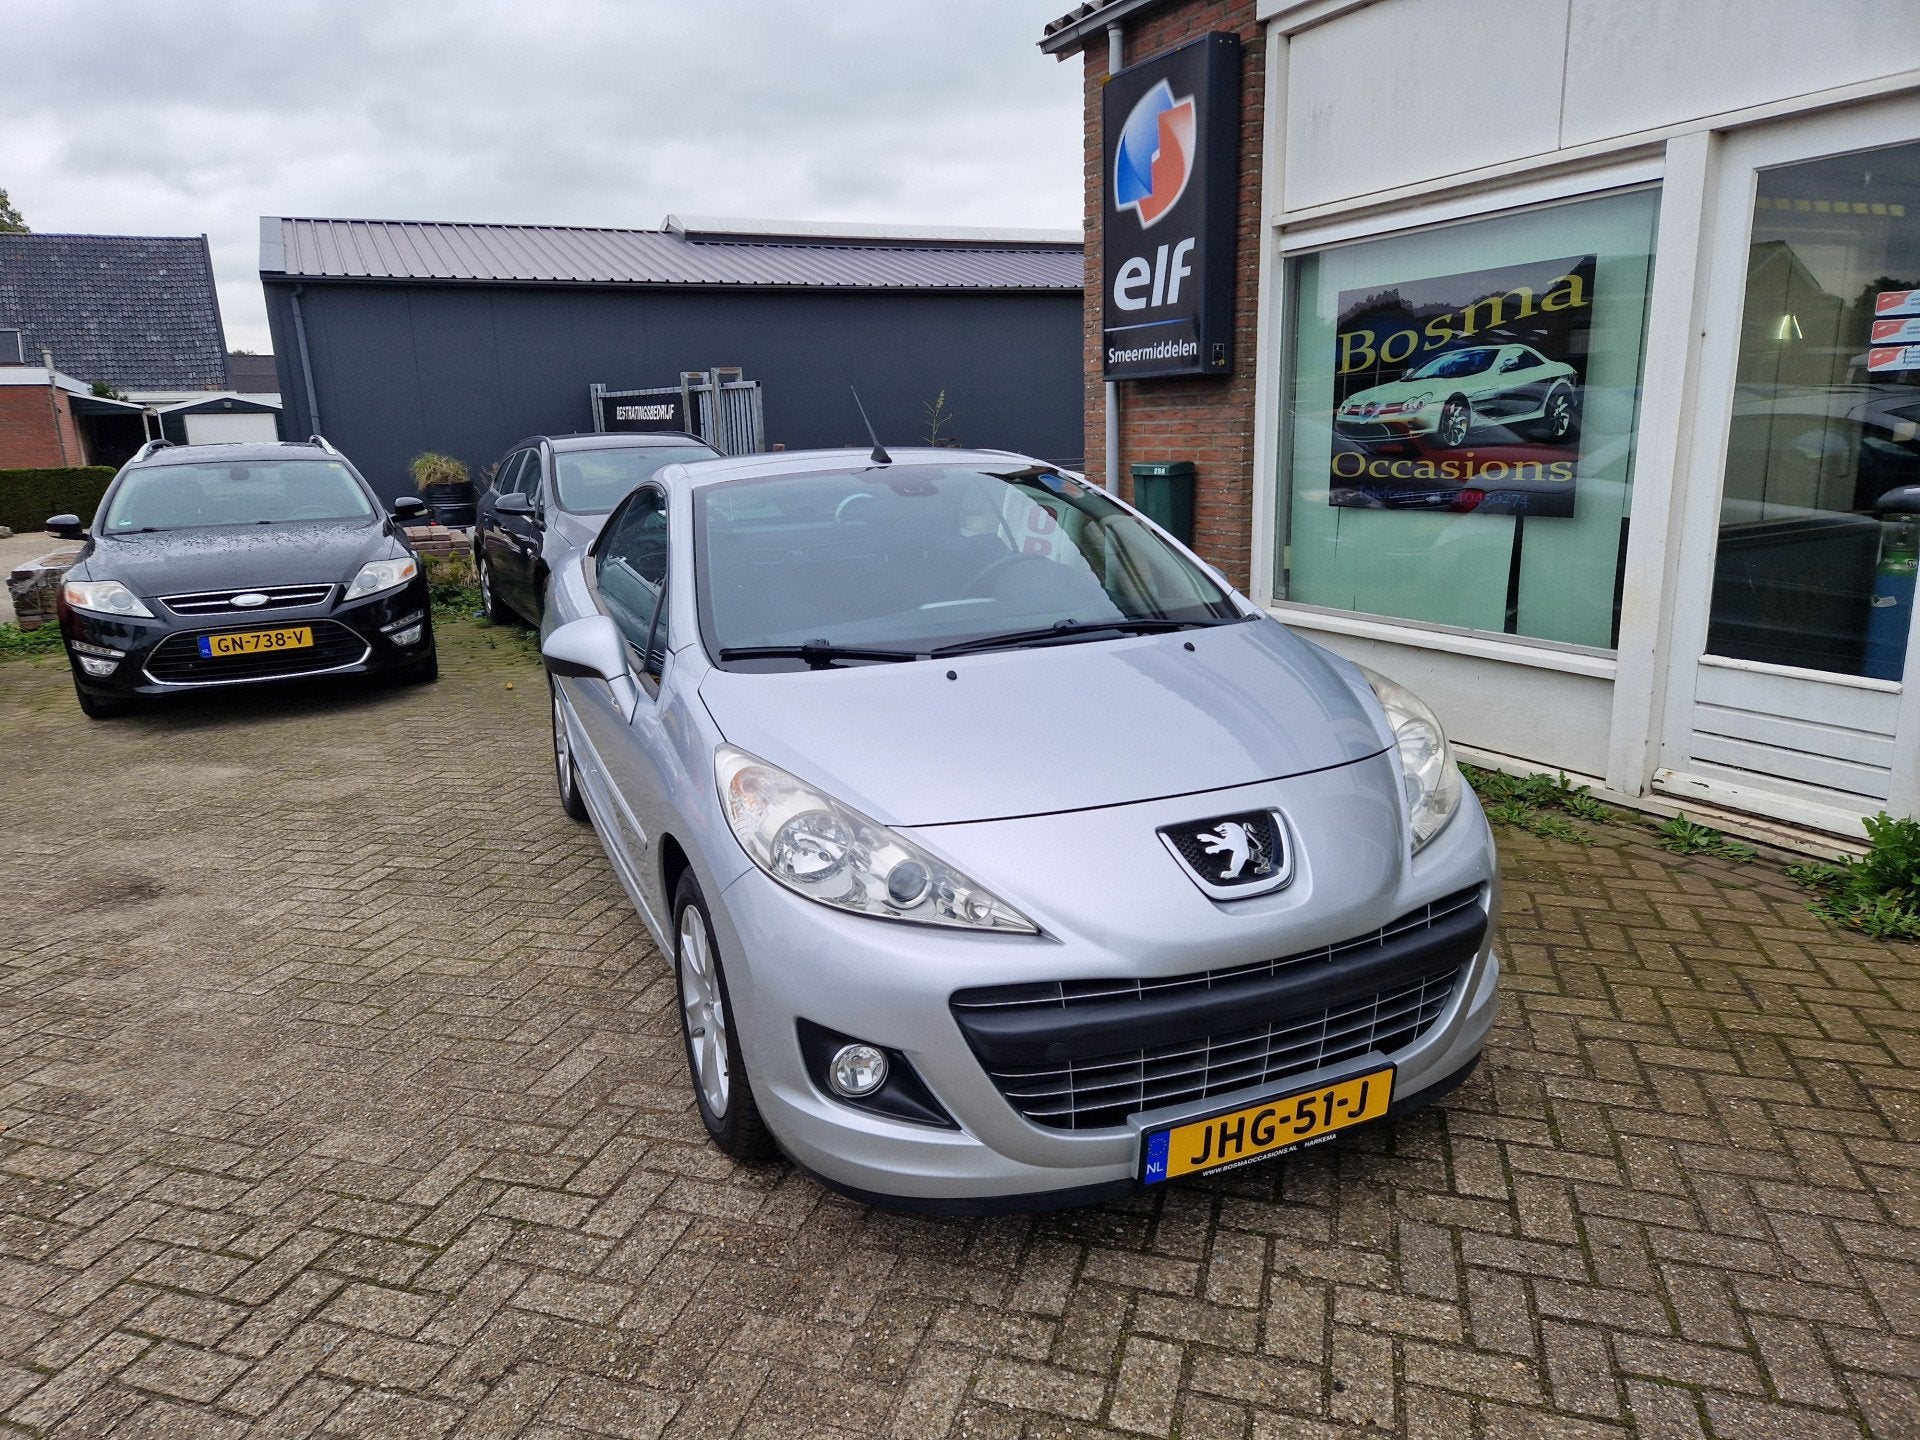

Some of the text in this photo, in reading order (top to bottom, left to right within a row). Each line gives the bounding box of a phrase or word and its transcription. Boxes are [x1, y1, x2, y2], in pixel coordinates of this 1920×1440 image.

[1113, 236, 1196, 312] elf
[1336, 273, 1589, 375] Bosma
[1107, 338, 1198, 365] Smeermiddelen
[616, 403, 675, 421] BESTRATINGSBEDRIJF
[1331, 451, 1574, 483] Occasions
[216, 630, 304, 653] GN-738-V
[1146, 1079, 1370, 1175] NL JHG-51-J
[1202, 1132, 1338, 1177] WWW.BOSMAOCCASIONS.NL HARKEMA
